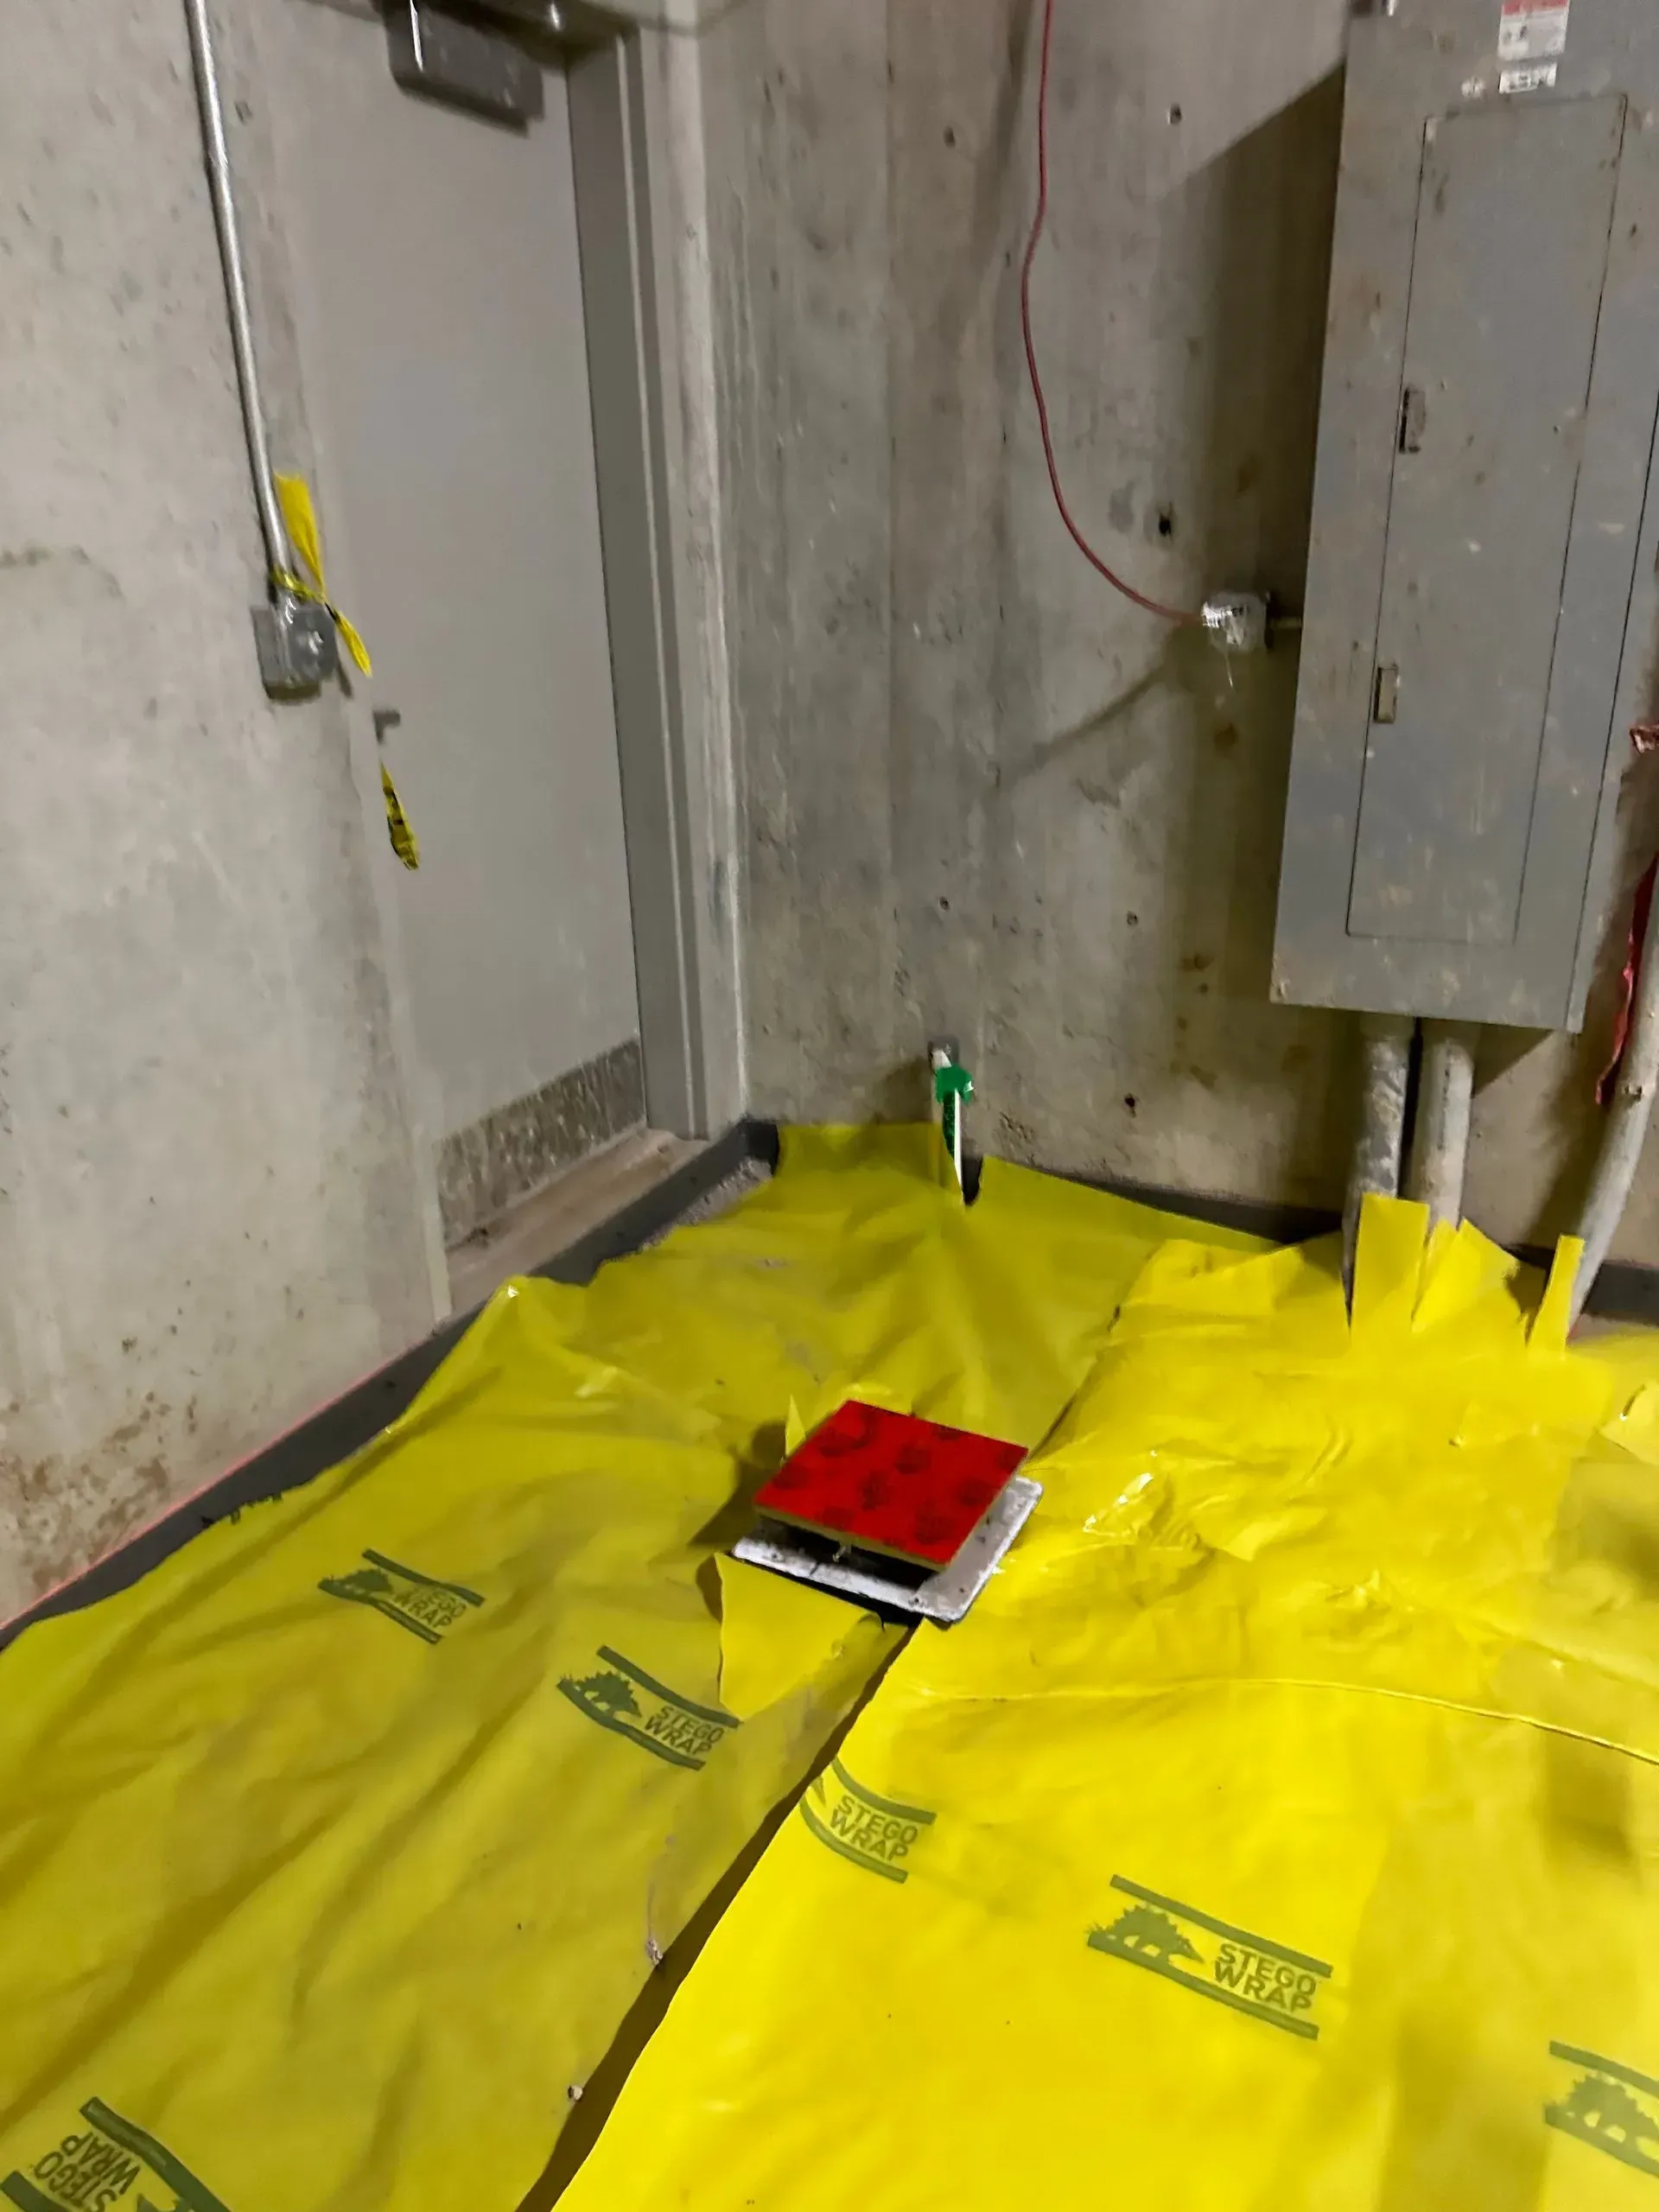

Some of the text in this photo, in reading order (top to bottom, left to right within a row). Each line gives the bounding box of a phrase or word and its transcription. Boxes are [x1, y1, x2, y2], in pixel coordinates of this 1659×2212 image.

[404, 1585, 467, 1619] EGO
[645, 1715, 713, 1755] WRAP
[658, 1705, 725, 1744] STEGO
[830, 1807, 910, 1861] WRAP
[838, 1795, 918, 1845] STEGO
[1214, 1956, 1313, 2012] WRAP
[1220, 1942, 1317, 1997] STEGO
[33, 2151, 118, 2212] STEGO
[60, 2131, 142, 2196] WRAP
